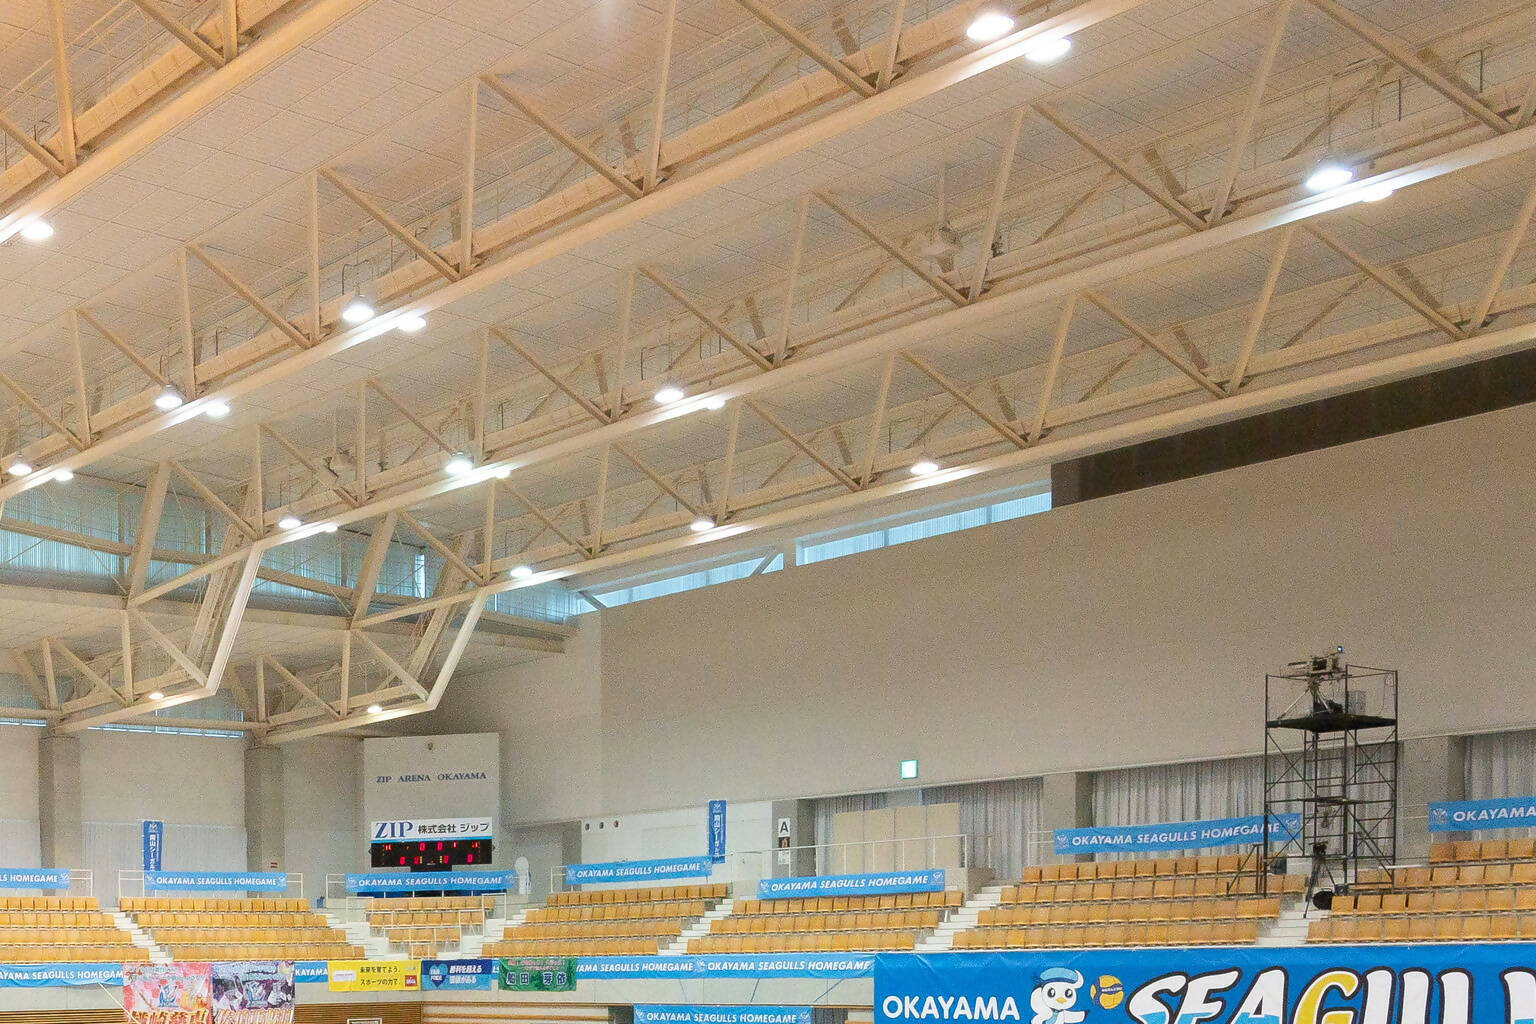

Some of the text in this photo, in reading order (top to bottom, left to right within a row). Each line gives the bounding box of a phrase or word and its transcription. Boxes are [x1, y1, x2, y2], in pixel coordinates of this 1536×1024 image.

[376, 772, 487, 783] ZIP ARENA OKAYAMA
[375, 821, 414, 839] ZIP
[418, 823, 457, 834] 株式会社
[779, 820, 789, 833] A
[1071, 822, 1280, 847] OKAYAMA SEAGULLS HOMEGAME
[577, 863, 701, 879] OKAYAMA SEAGULLS HOMEGAME
[10, 873, 58, 884] HOMEGAME
[156, 876, 277, 887] OKAYAMA SEAGULLS HOMEGAME
[358, 876, 502, 887] OKAYAMA SEAGULLS HOMEGAME
[771, 875, 929, 892] OKAYAMA SEAGULLS HOMEGAME
[600, 963, 639, 972] SEAGULLS
[642, 962, 693, 972] HOMEGAME
[708, 959, 870, 972] OKAYAMA SEAGULLS HOMEGAME
[32, 970, 75, 980] SEAGULLS
[882, 995, 1020, 1020] OKAYAMA
[647, 1012, 797, 1024] OKAYAMA SEAGULLS HOMEGAME
